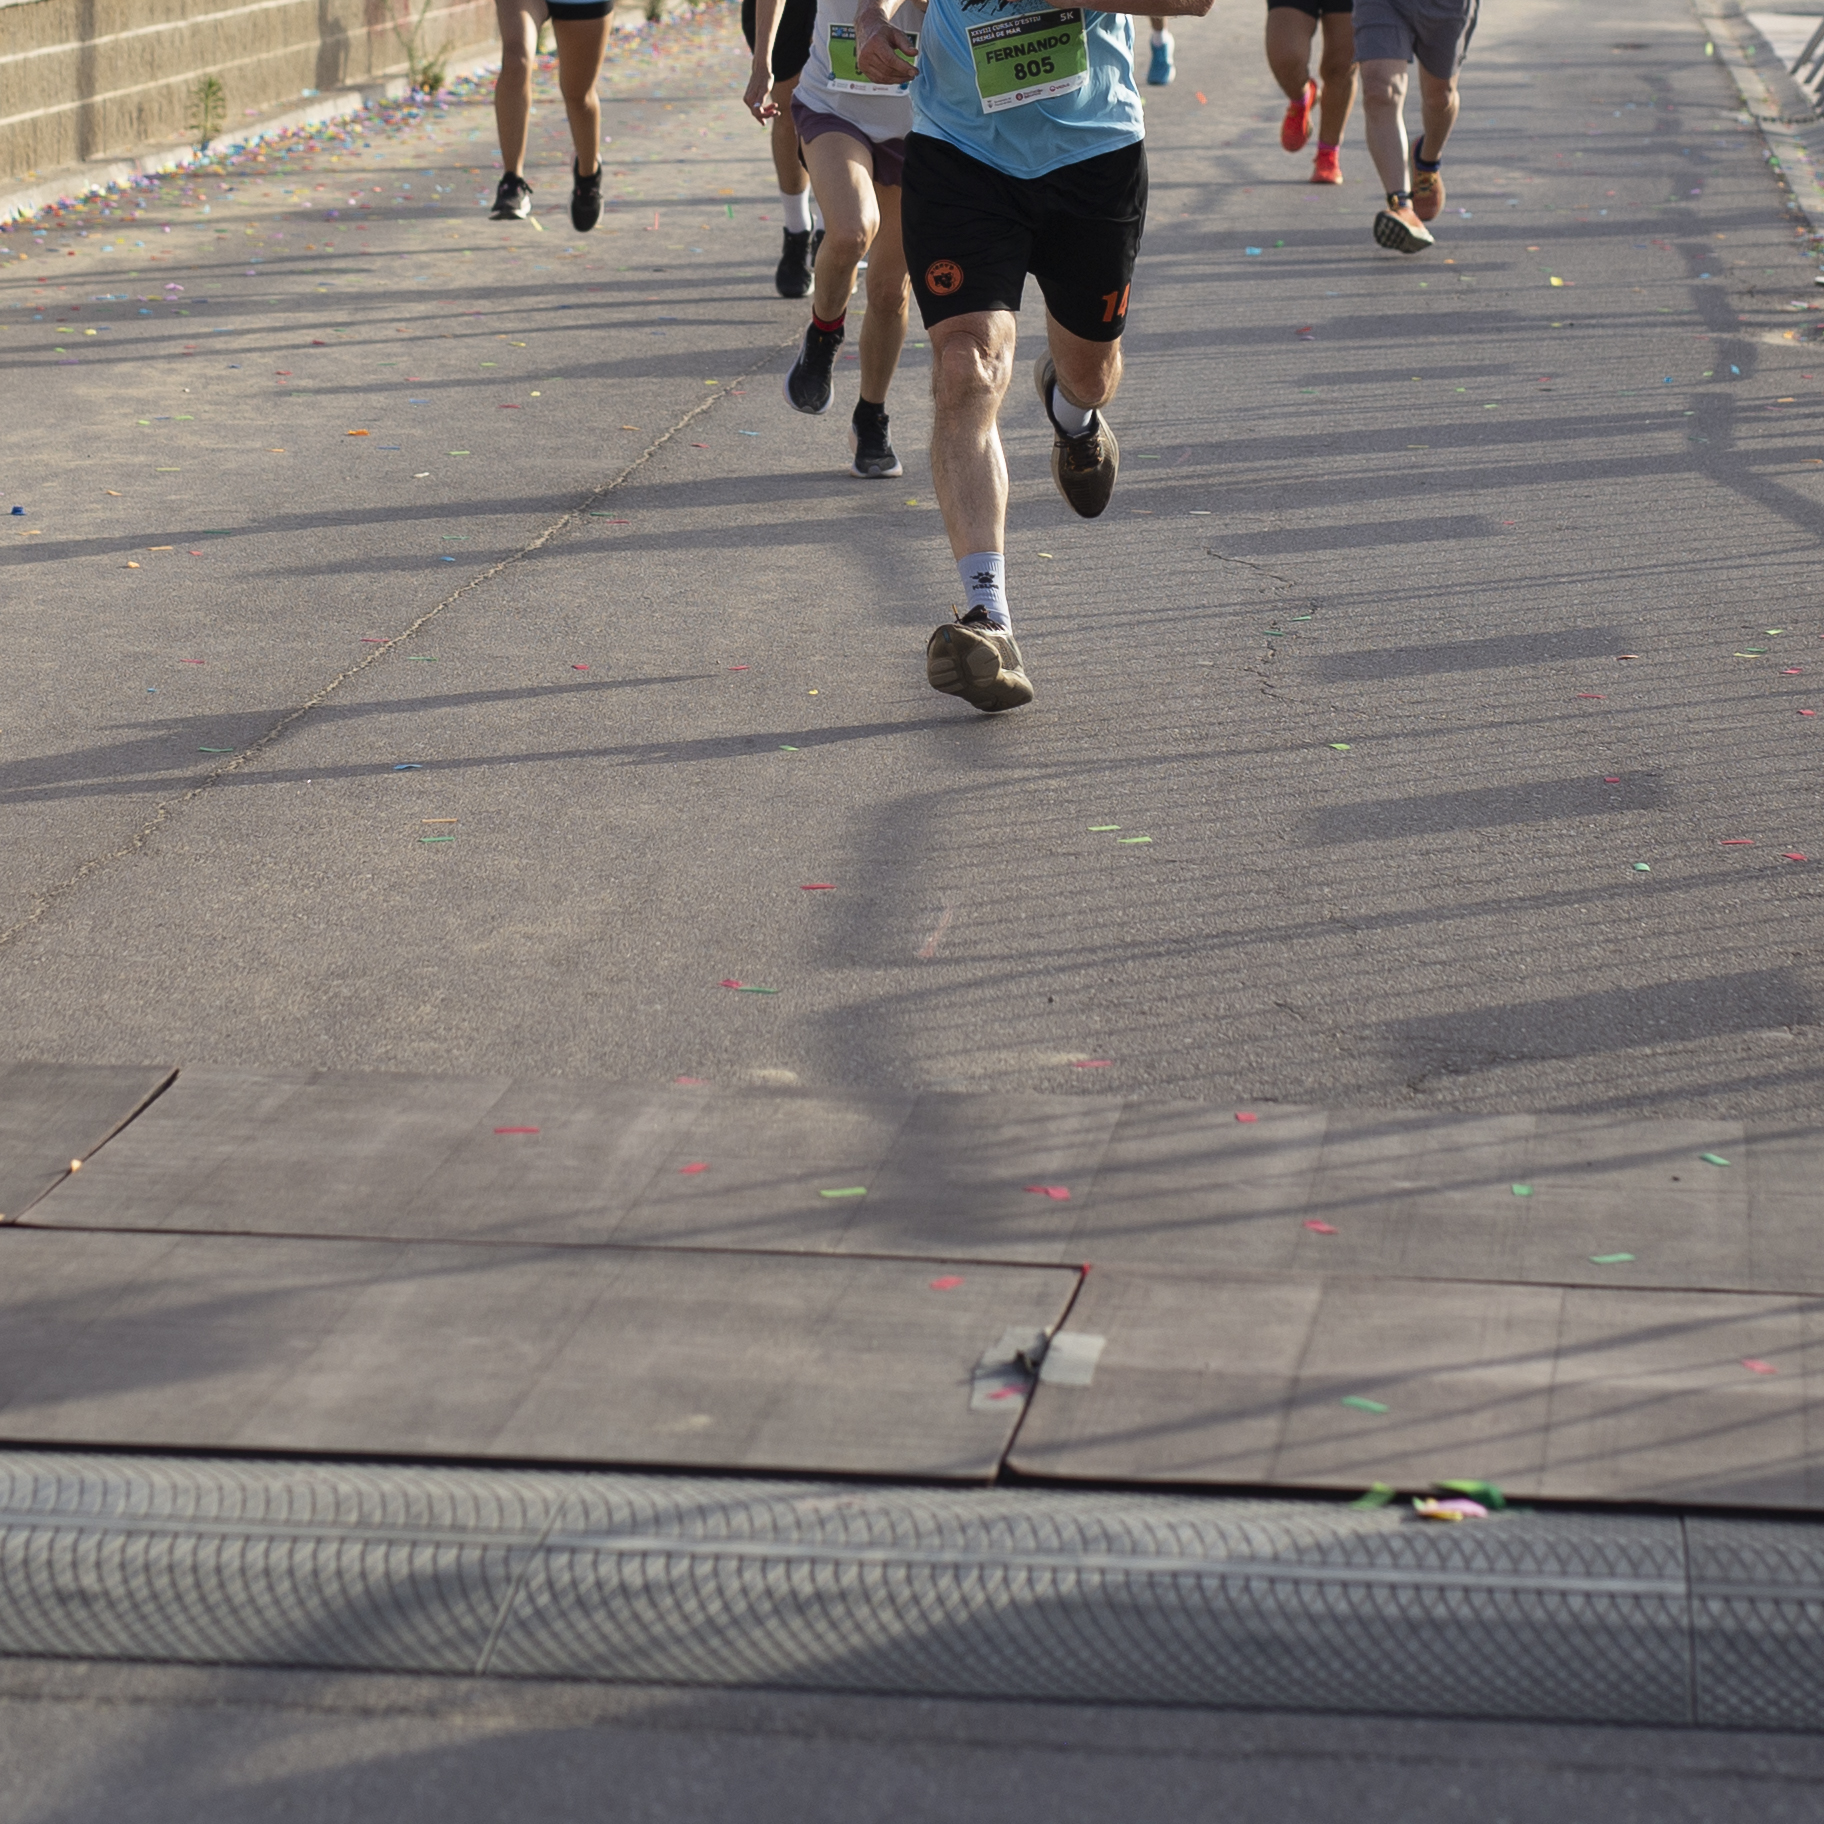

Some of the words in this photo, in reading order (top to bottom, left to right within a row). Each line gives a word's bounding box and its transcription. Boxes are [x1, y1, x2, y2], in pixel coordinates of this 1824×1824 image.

[991, 21, 1014, 32] CURSA
[1014, 15, 1041, 26] D'ESTIU
[1060, 11, 1074, 22] 5K
[995, 29, 1005, 38] DE
[1005, 26, 1022, 36] MAR
[985, 32, 1071, 65] FERNANDO
[1013, 55, 1055, 81] 805
[1102, 282, 1130, 322] 14
